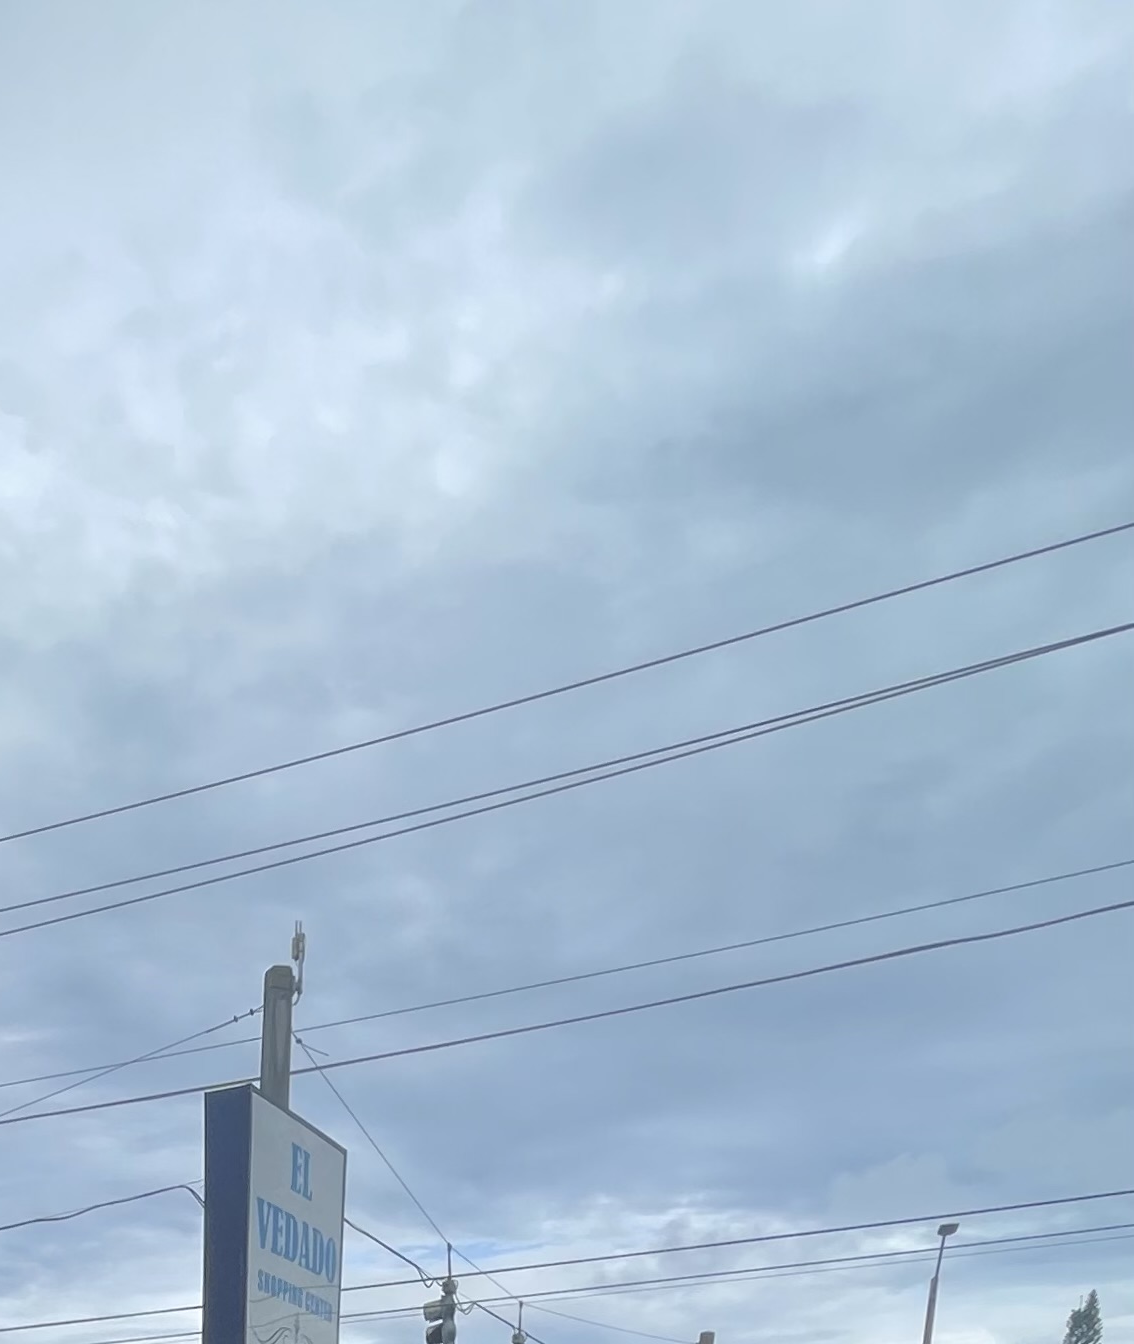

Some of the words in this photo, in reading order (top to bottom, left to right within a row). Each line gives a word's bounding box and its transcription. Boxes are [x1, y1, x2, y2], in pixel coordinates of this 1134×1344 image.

[291, 1142, 312, 1201] EL
[257, 1196, 336, 1283] VEDADO
[258, 1269, 303, 1308] SHOPPING
